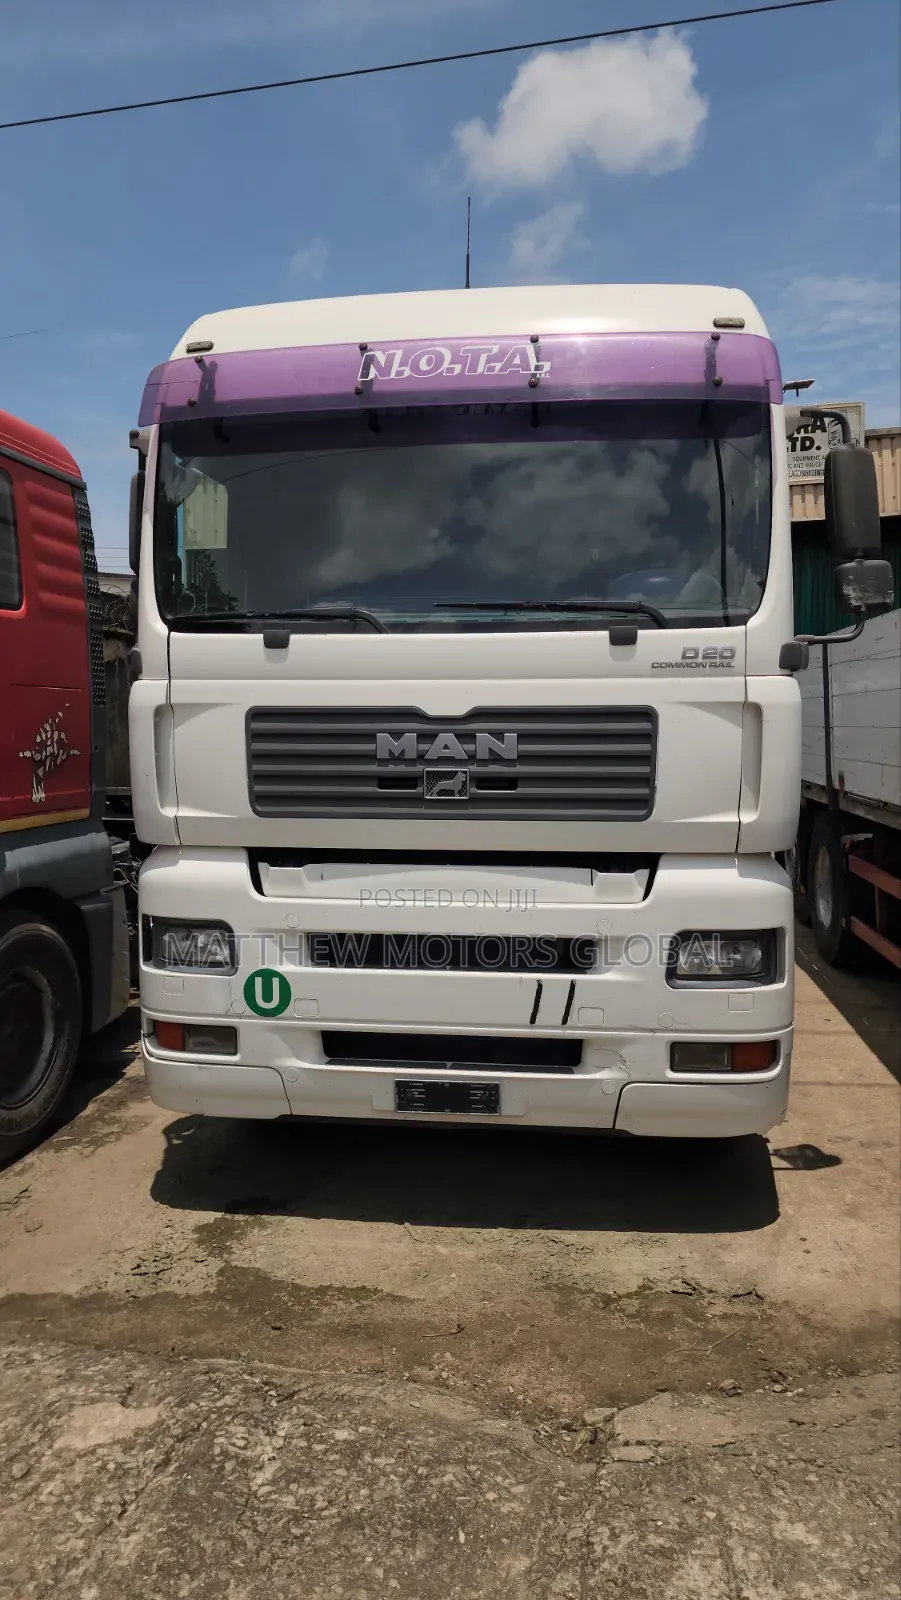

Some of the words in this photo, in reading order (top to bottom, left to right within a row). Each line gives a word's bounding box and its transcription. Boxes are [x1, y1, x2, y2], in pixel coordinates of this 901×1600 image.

[357, 344, 552, 381] N.O.T.A.
[709, 661, 735, 669] RAIL
[376, 732, 518, 760] MAN
[254, 976, 280, 1009] U
